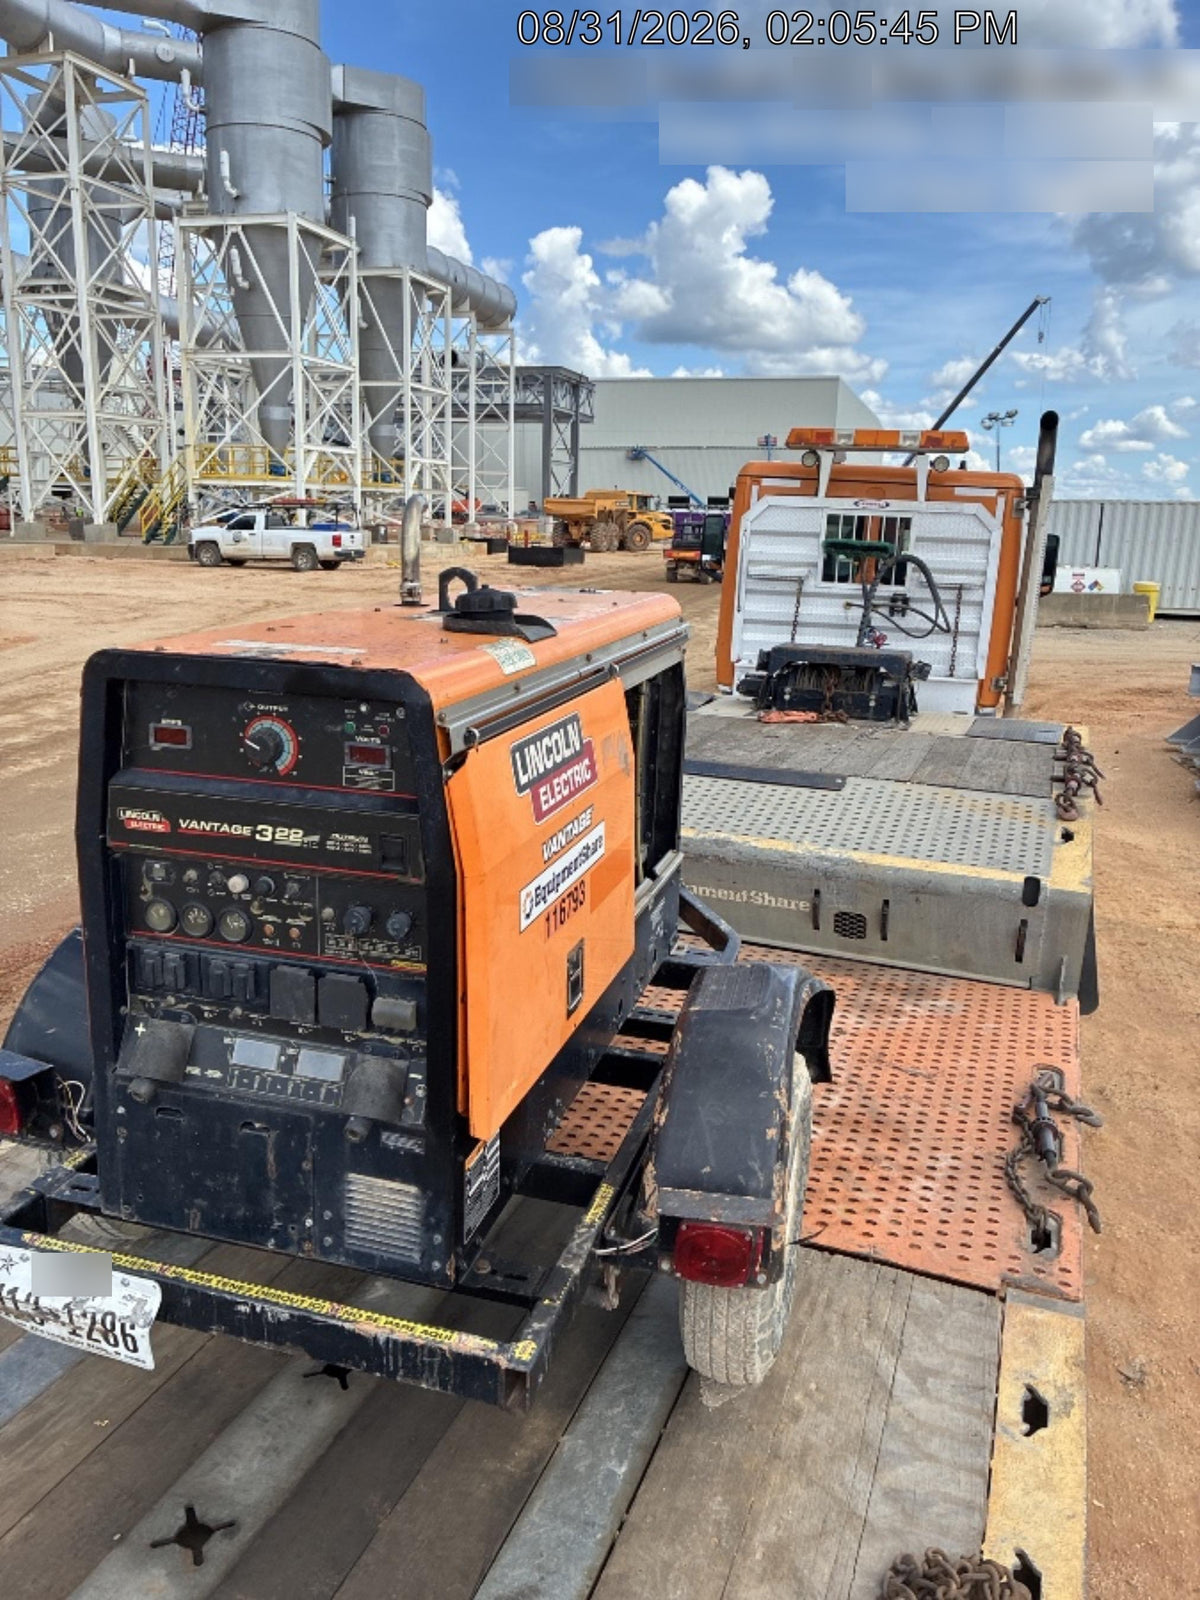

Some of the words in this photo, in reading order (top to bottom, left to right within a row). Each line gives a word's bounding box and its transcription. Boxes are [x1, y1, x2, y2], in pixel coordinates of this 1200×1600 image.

[515, 721, 581, 785] LINCOLN
[539, 758, 591, 812] ELECTRIC
[119, 809, 161, 821] LINCOLN
[178, 819, 253, 836] VANTAGE
[543, 806, 593, 862] VANTAGE
[534, 834, 604, 907] EquipmentShare
[545, 880, 586, 939] 116793
